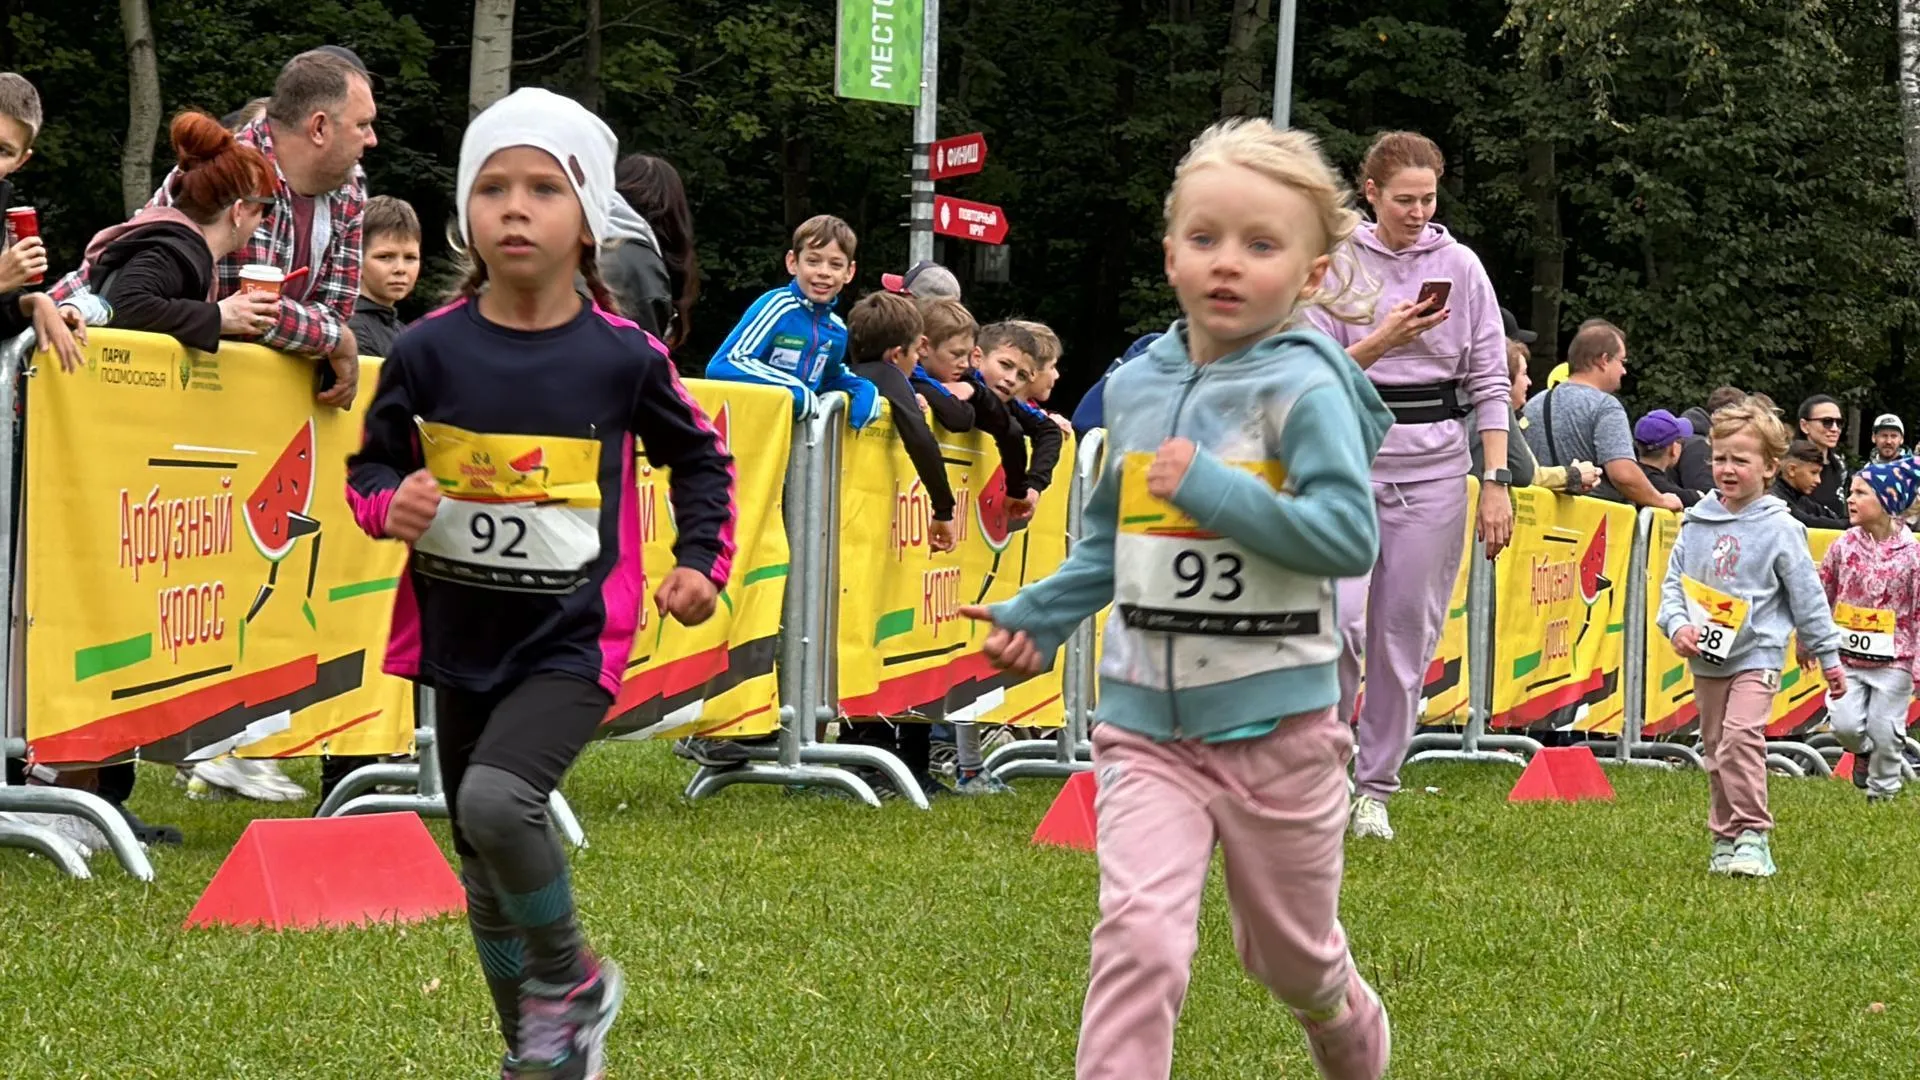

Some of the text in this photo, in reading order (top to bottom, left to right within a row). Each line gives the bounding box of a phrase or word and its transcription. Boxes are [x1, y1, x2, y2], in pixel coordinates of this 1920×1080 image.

[947, 142, 979, 168] ФИНИШ
[102, 347, 131, 365] ПАРКИ
[100, 367, 166, 388] ПОДМОСКОВЬЯ
[120, 476, 233, 583] Арбузный
[470, 511, 529, 559] 92
[1173, 549, 1244, 602] 93
[158, 580, 225, 665] кросс
[1699, 625, 1724, 650] 98
[1849, 633, 1871, 651] 90
